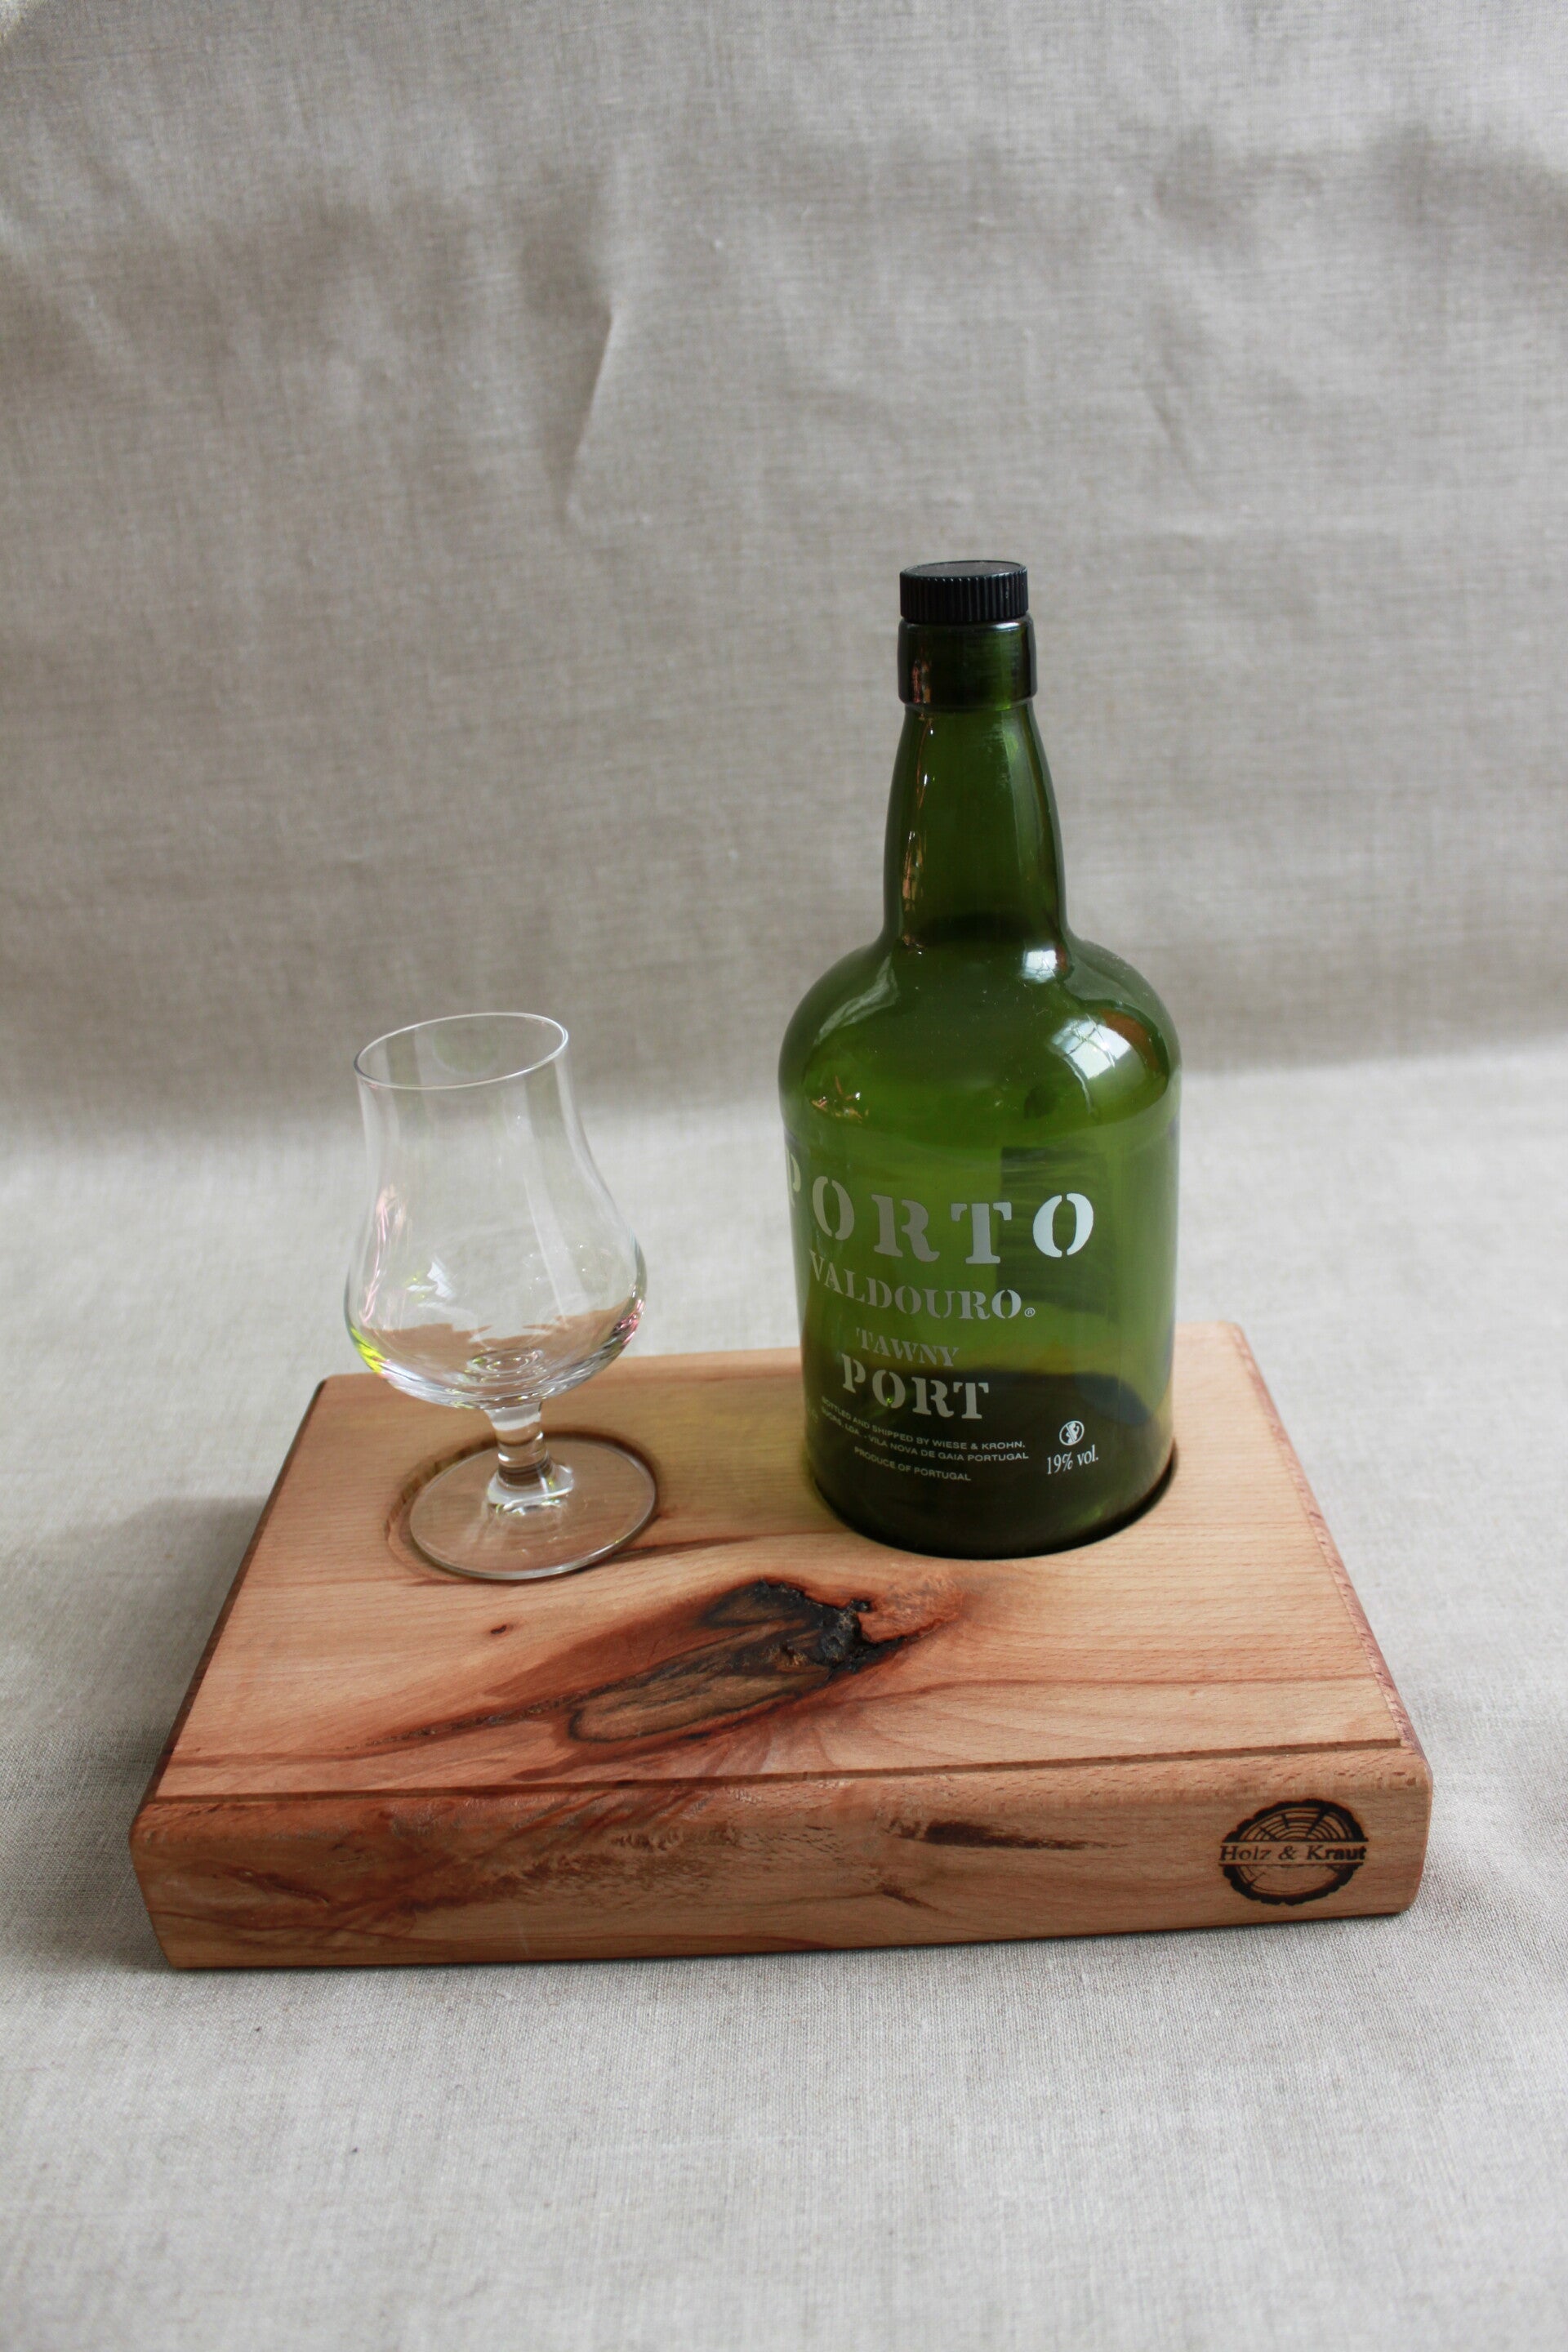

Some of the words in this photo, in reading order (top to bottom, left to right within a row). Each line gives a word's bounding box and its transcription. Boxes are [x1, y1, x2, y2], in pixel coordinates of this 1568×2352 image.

[855, 1326, 960, 1367] TAWNY
[840, 1352, 989, 1420] PORT
[853, 1416, 871, 1430] AND
[872, 1423, 914, 1443] SHIPPED
[915, 1437, 930, 1446] BY
[931, 1438, 968, 1450] WIESE
[970, 1441, 978, 1450] &
[981, 1441, 1026, 1450] KROHN.
[867, 1434, 889, 1448] VILA
[889, 1441, 918, 1455] NOVA
[920, 1449, 936, 1459] DE
[938, 1451, 964, 1462] GAIA
[967, 1452, 1029, 1463] PORTUGAL
[853, 1445, 897, 1469] PRODUCE
[898, 1462, 912, 1472] OF
[914, 1466, 972, 1482] PORTUGAL
[1046, 1451, 1074, 1475] 19%
[1076, 1443, 1099, 1467] vol.
[1218, 1844, 1272, 1861] Holz
[1277, 1844, 1297, 1861] &
[1307, 1842, 1368, 1861] Kraut
